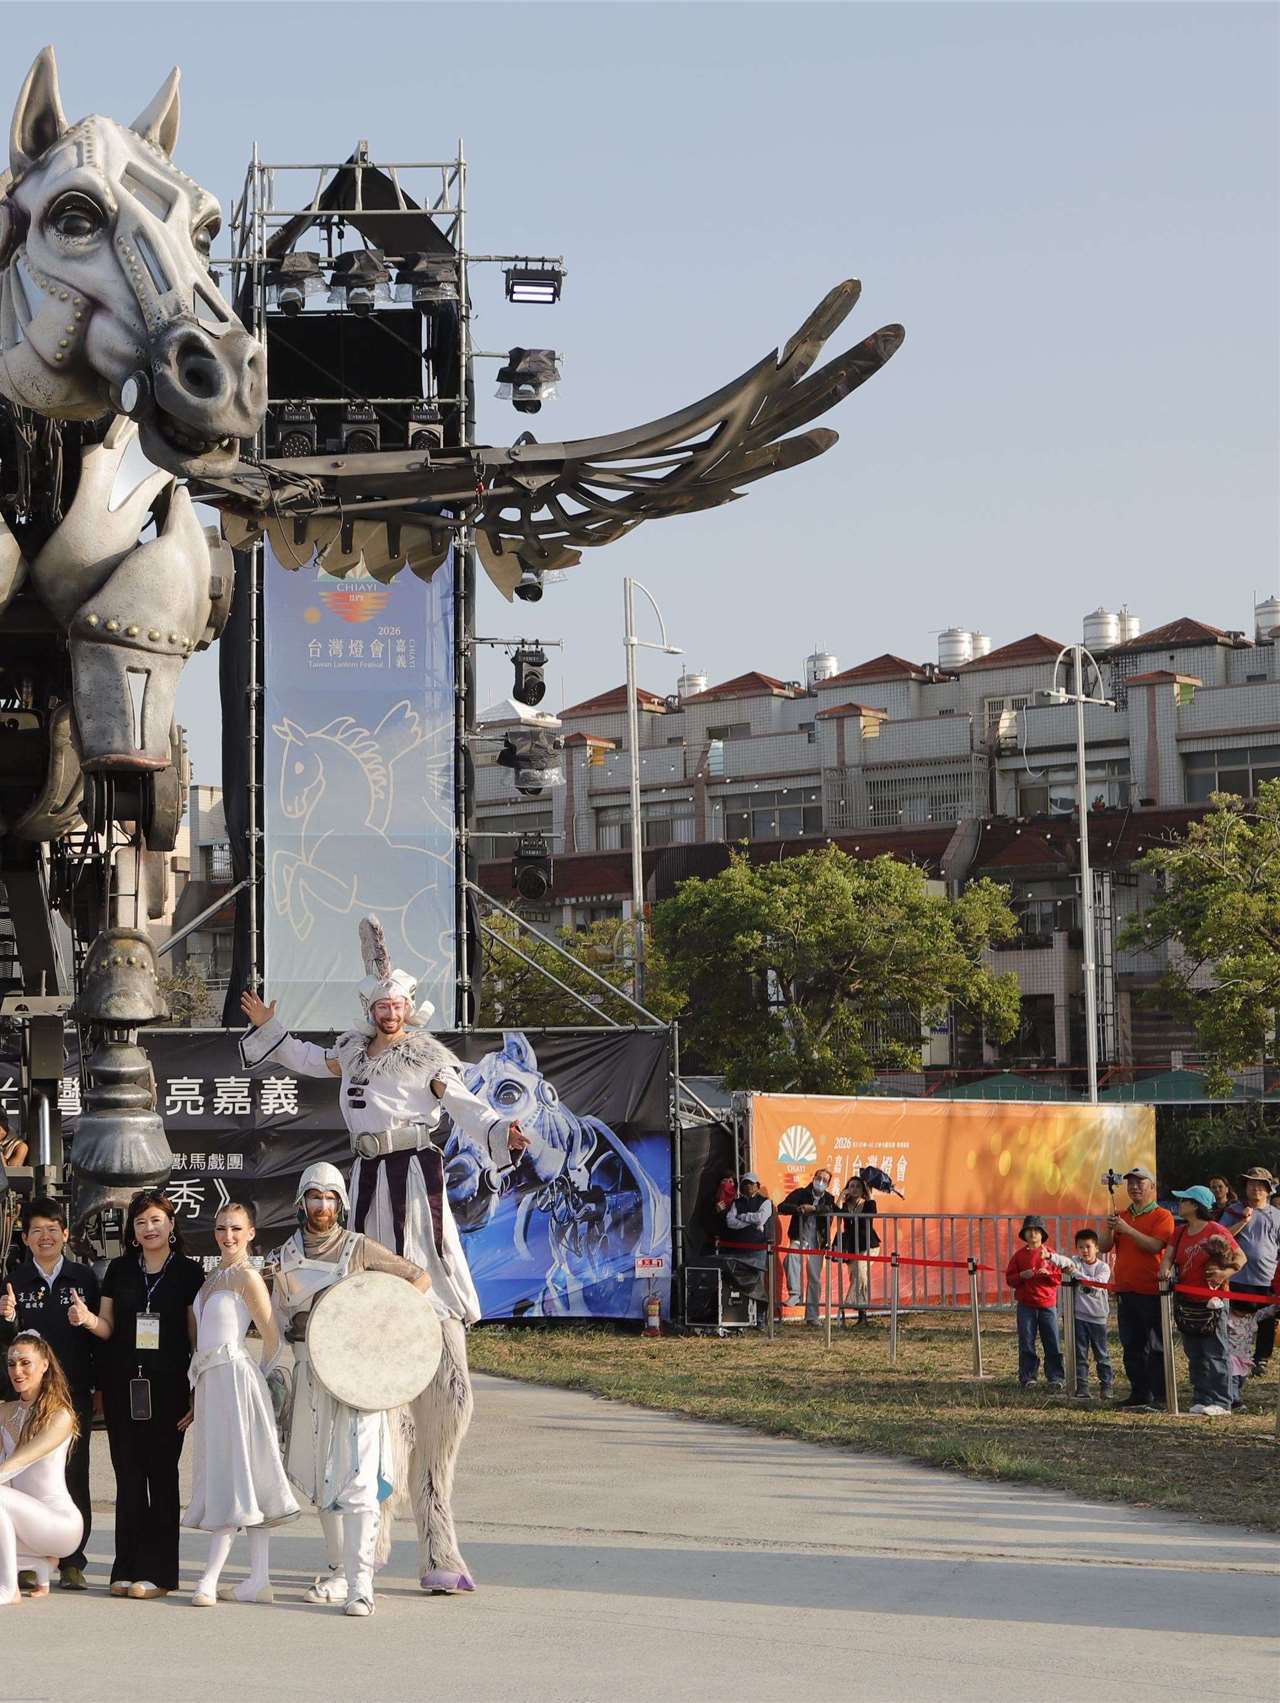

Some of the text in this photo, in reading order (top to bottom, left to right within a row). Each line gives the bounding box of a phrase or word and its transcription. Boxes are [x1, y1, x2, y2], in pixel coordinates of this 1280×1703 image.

[336, 583, 377, 592] CHIAYI
[378, 626, 401, 636] 2026
[308, 639, 385, 658] 台灣燈會
[166, 1075, 299, 1116] 亮嘉義
[168, 1152, 243, 1171] 獸馬戲團
[143, 1178, 230, 1219] 秀》
